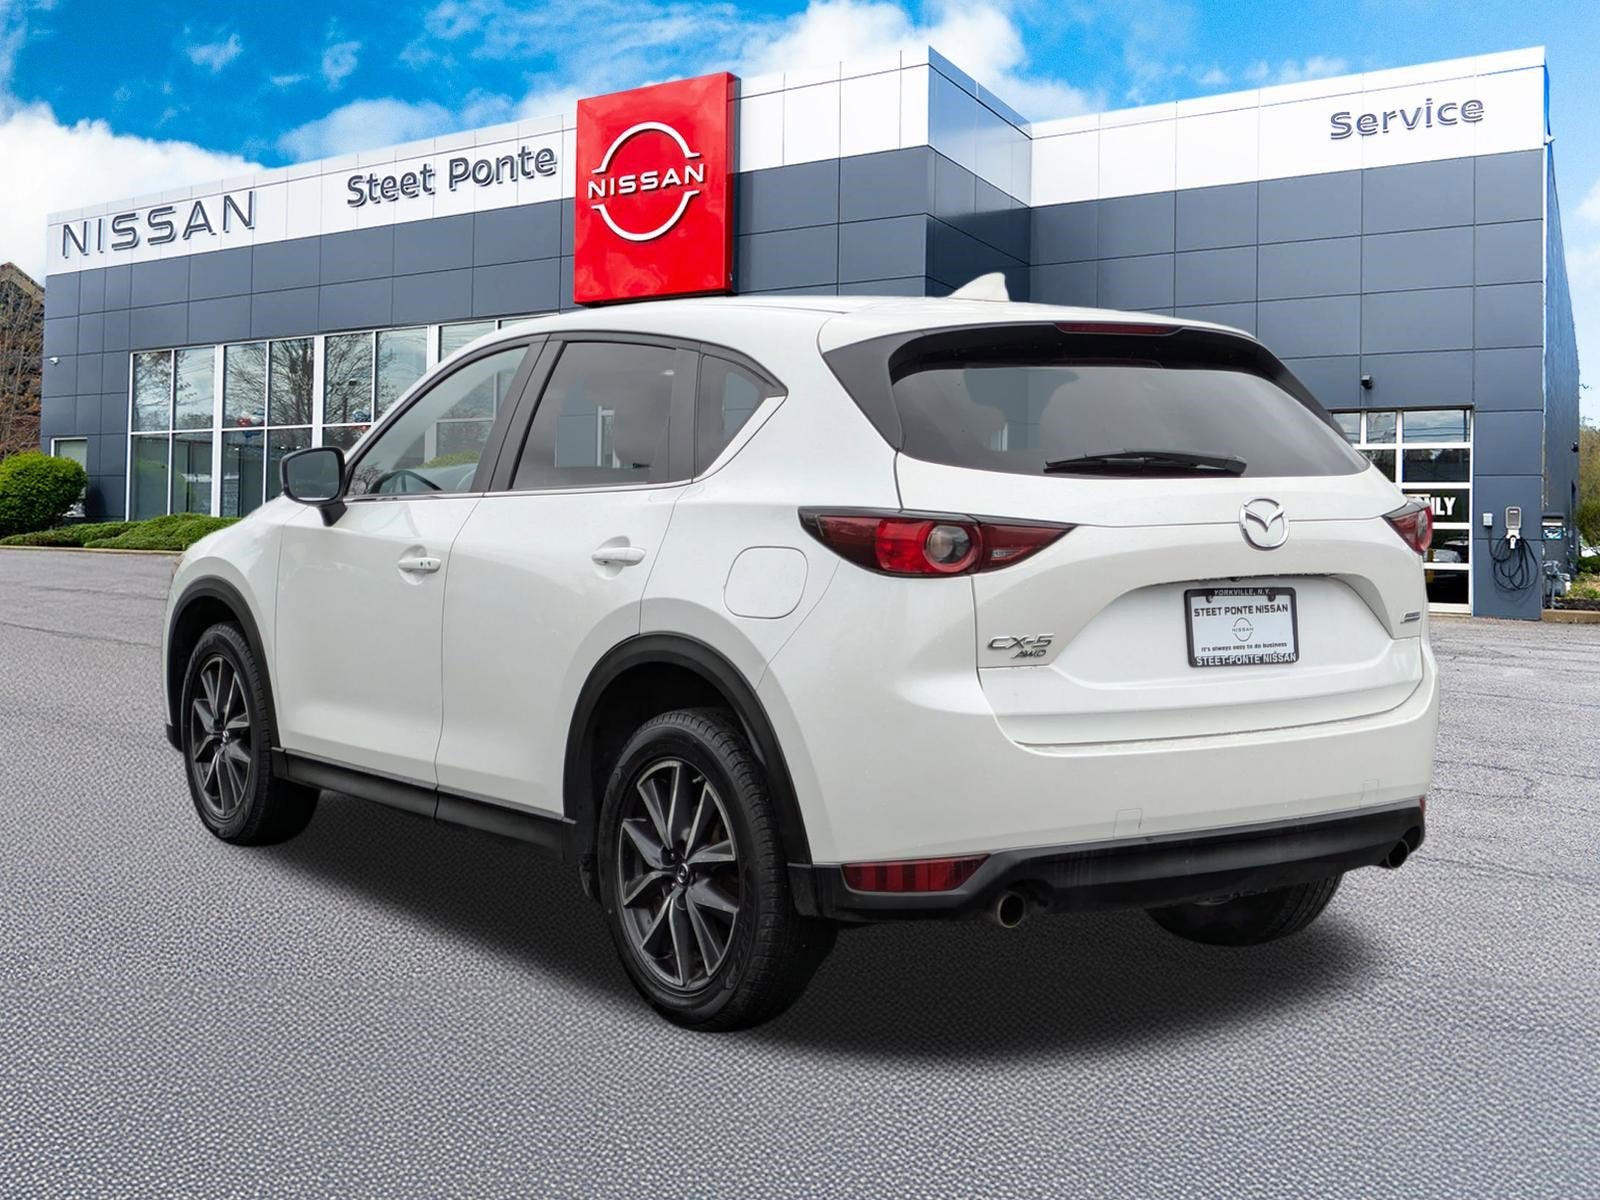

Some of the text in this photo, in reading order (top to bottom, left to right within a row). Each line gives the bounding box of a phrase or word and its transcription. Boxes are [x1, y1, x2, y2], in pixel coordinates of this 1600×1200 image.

[1330, 98, 1484, 139] Service
[347, 145, 557, 207] Steet Ponte
[587, 163, 705, 199] NISSAN
[62, 190, 255, 259] NISSAN
[1421, 496, 1457, 516] NLY
[1193, 603, 1289, 617] STEET PONTE NISSAN
[987, 634, 1054, 649] CX-5
[1010, 649, 1046, 659] AWD
[1262, 652, 1297, 663] NISSAN
